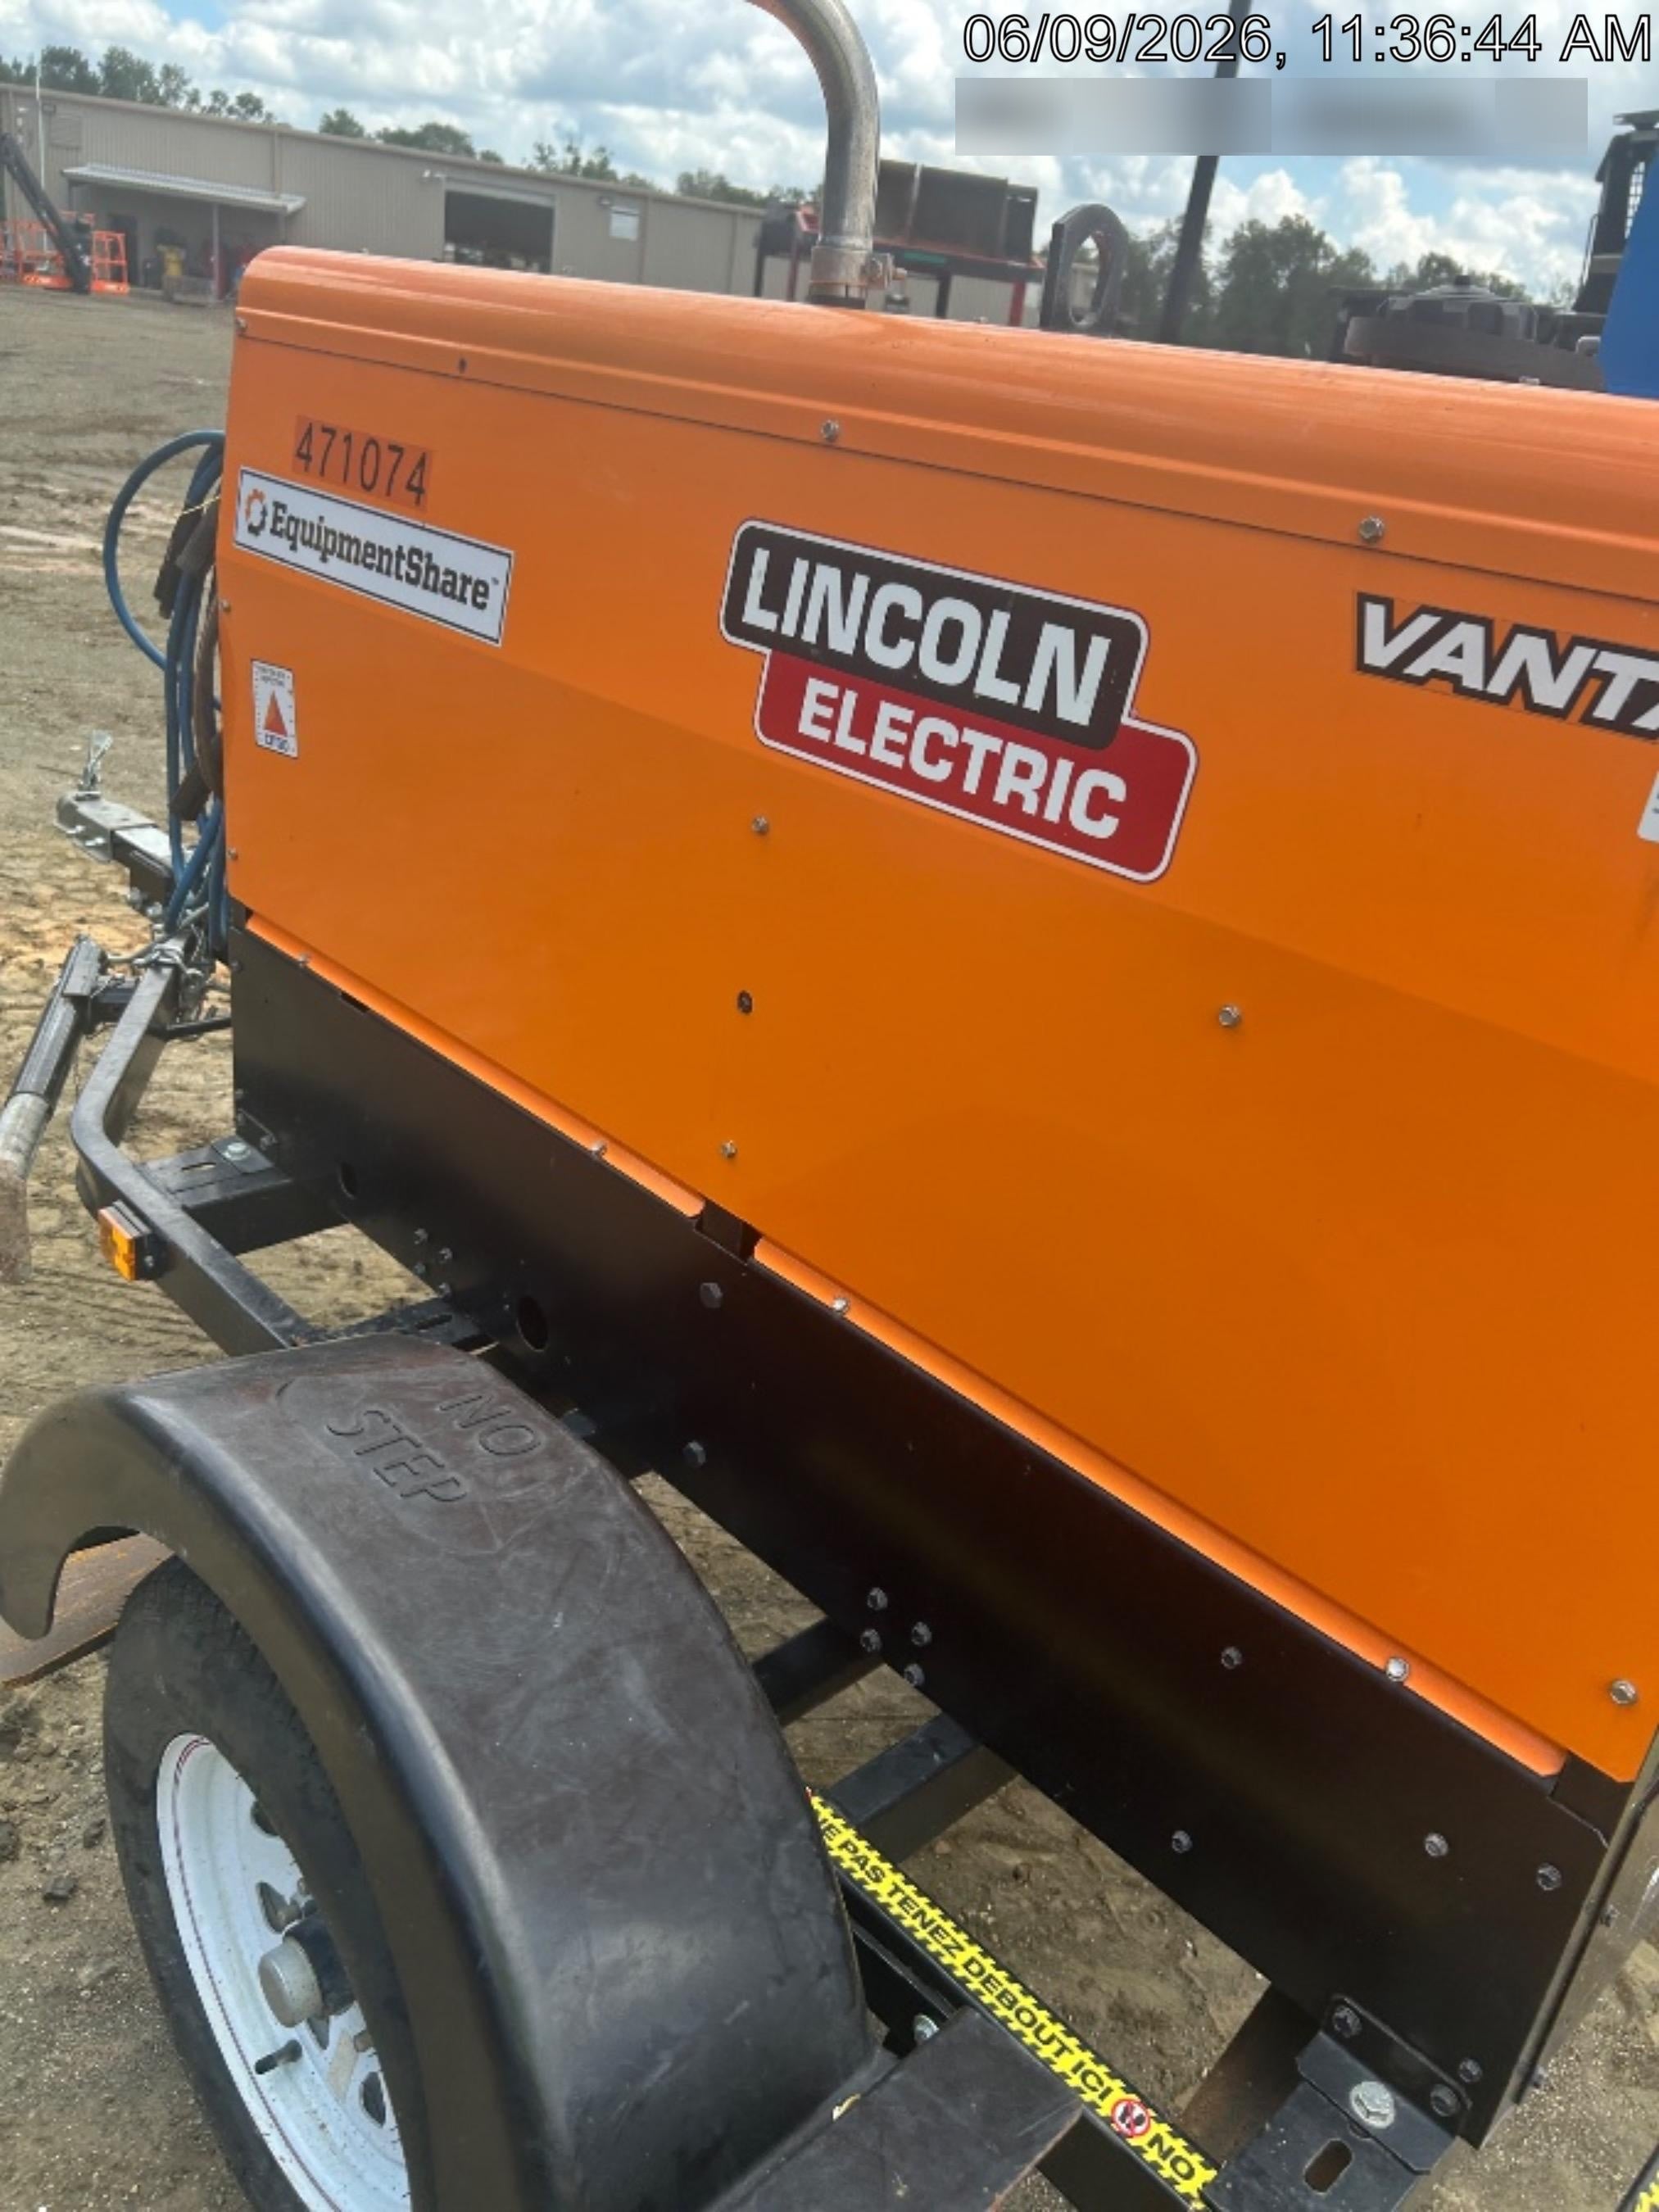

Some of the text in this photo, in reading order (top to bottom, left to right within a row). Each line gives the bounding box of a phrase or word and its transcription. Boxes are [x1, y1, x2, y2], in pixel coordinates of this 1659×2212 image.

[295, 422, 428, 506] 471074
[269, 500, 491, 611] EquipmentShare
[741, 547, 1112, 727] LINCOLN
[797, 677, 1127, 840] ELECTRIC
[324, 1407, 470, 1504] STEP
[435, 1393, 546, 1458] NO
[838, 1840, 885, 1883] PAS
[887, 1881, 968, 1956] TENEZ
[962, 1956, 1075, 2057] DEBOUT
[1070, 2059, 1113, 2101] ICI
[1147, 2133, 1195, 2181] NO
